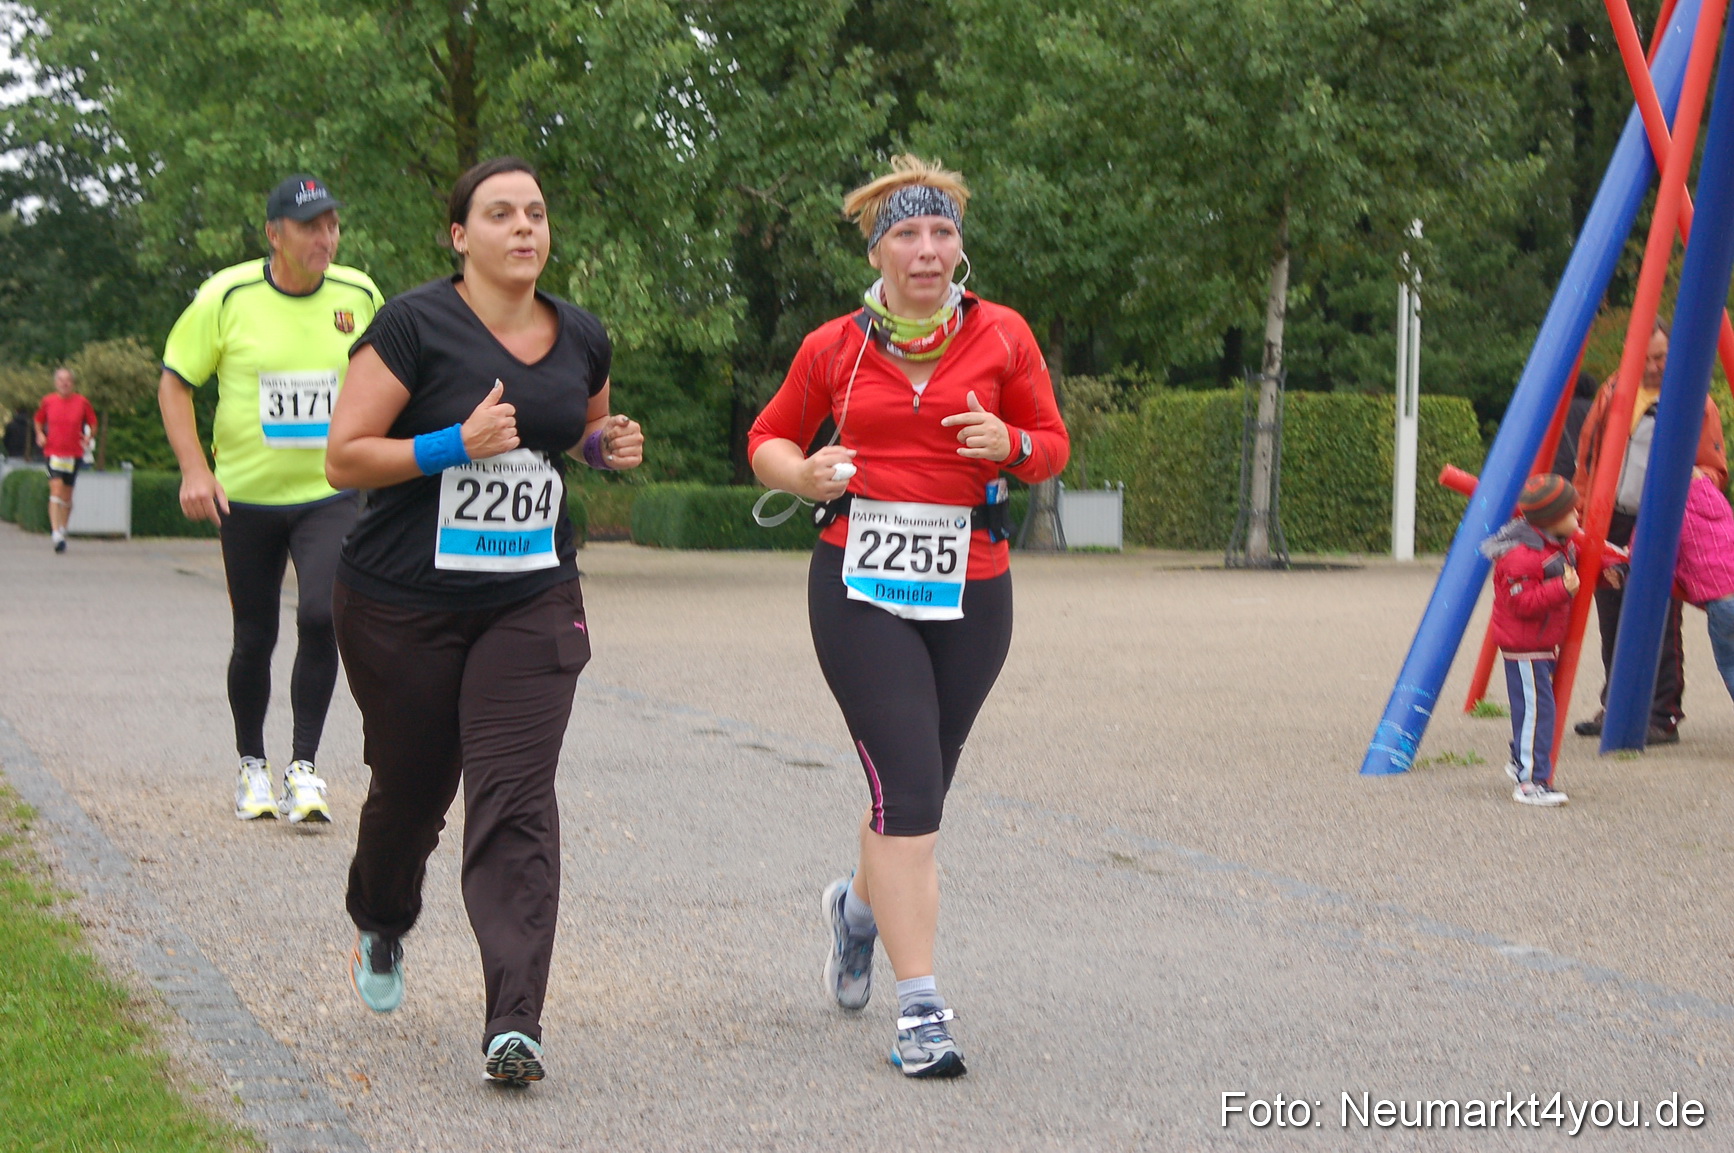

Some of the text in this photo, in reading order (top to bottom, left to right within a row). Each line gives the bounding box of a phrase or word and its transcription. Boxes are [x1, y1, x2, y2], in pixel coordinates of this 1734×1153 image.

[269, 390, 331, 418] 3171
[454, 479, 553, 522] 2264
[852, 512, 950, 528] PARTL Neumarkt
[475, 535, 531, 556] Angela
[857, 530, 957, 574] 2255
[875, 583, 933, 603] Daniela
